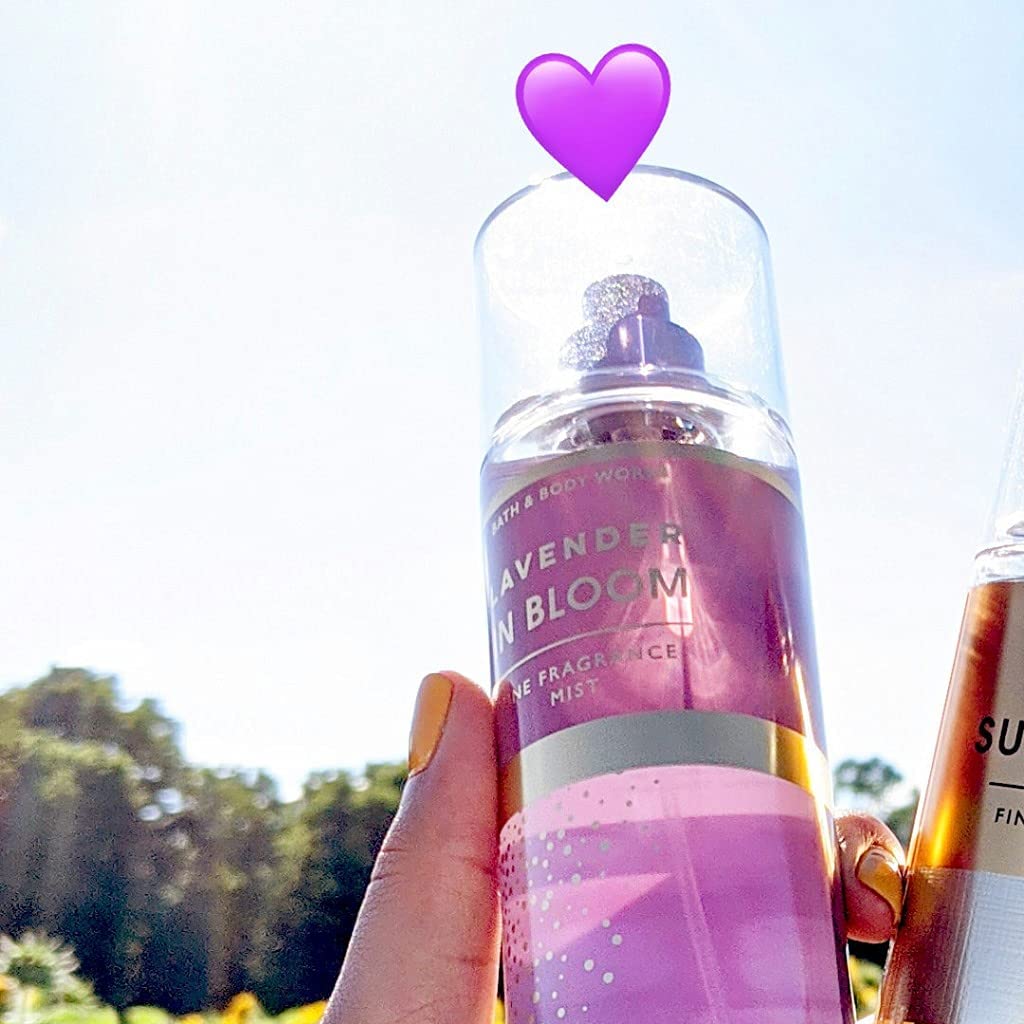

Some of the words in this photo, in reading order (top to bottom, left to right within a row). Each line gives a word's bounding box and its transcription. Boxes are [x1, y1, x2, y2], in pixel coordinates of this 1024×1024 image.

[491, 501, 520, 536] BATH
[524, 495, 533, 509] &
[539, 476, 587, 501] BODY
[526, 567, 688, 632] BLOOM
[538, 643, 678, 687] FRAGRANCE
[550, 677, 599, 707] MIST
